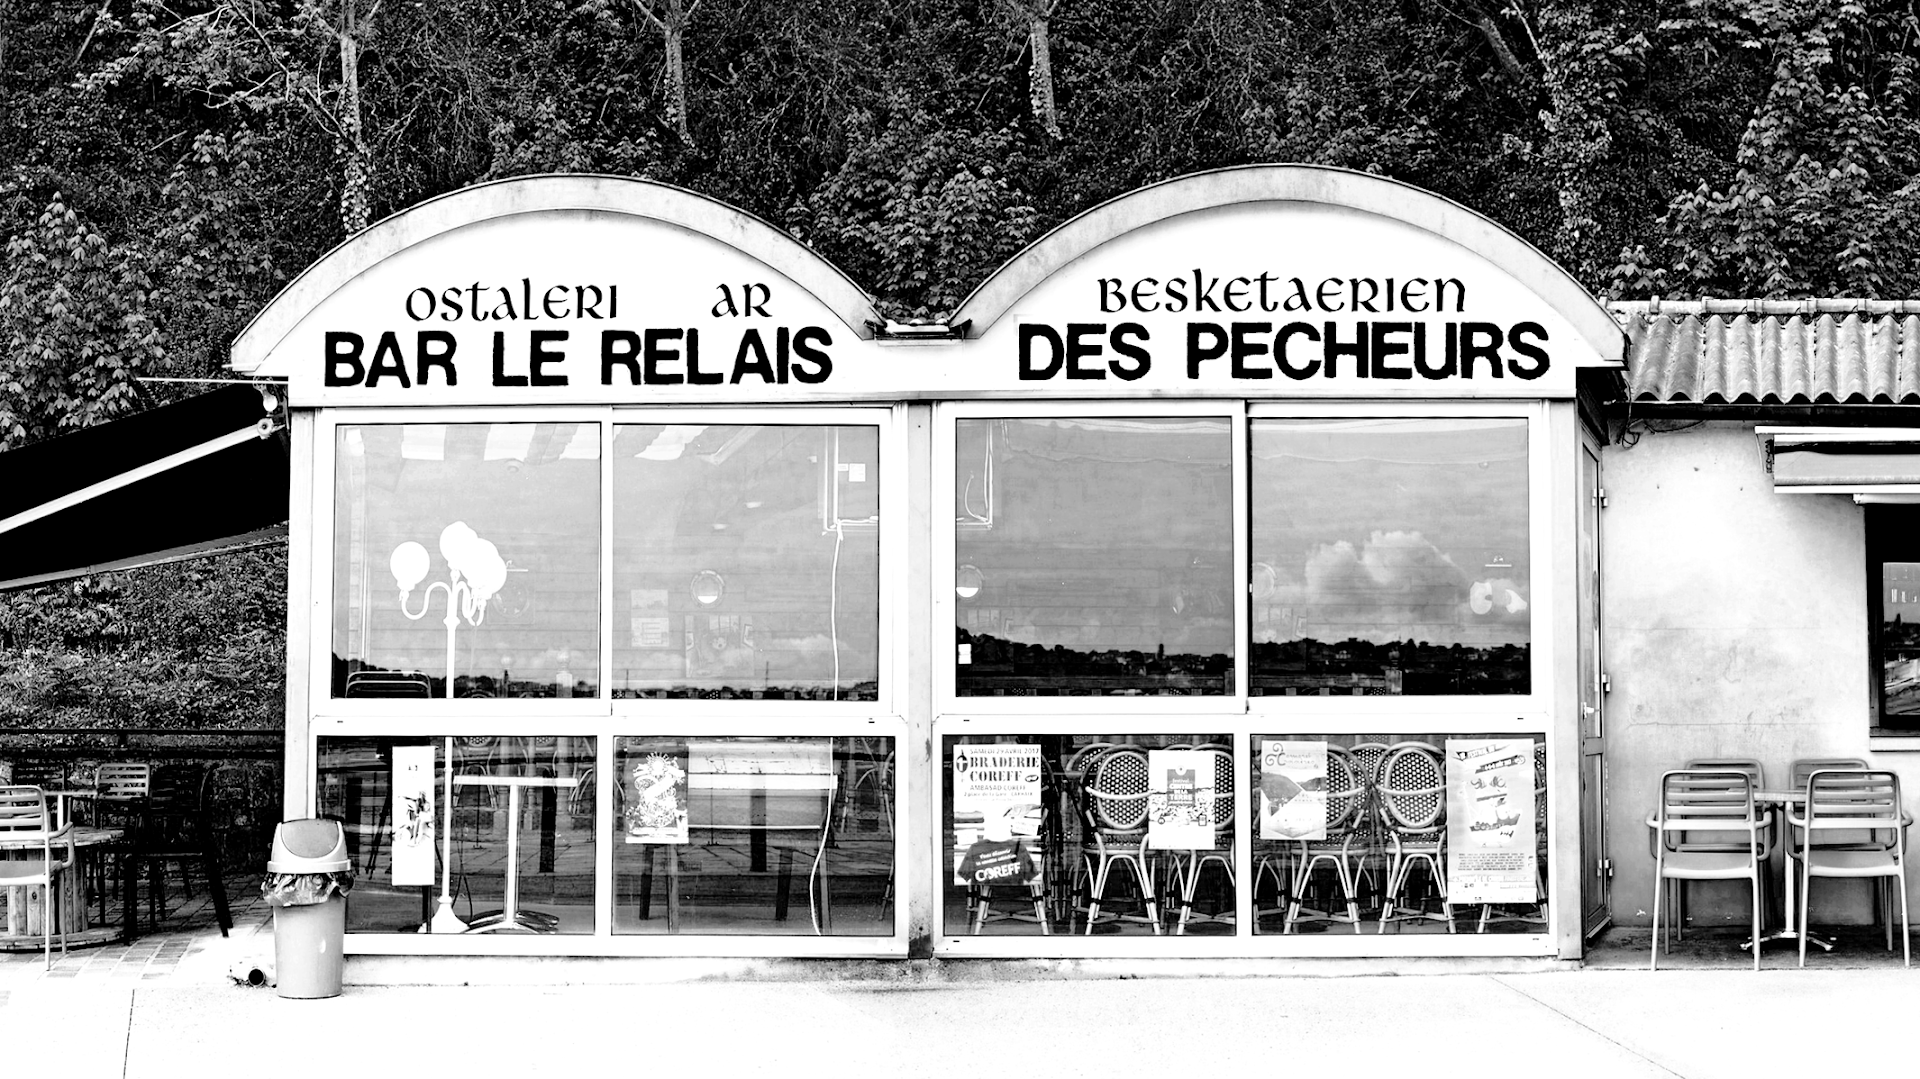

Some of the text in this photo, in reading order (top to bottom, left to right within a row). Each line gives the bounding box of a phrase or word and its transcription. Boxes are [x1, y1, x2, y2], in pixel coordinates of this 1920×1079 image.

[324, 326, 833, 388] BAR LE RELAIS
[1018, 321, 1551, 381] DES PECHEURS
[970, 756, 1040, 768] BRADERIE
[970, 770, 1023, 782] COREFF
[975, 862, 1021, 882] COREFF
